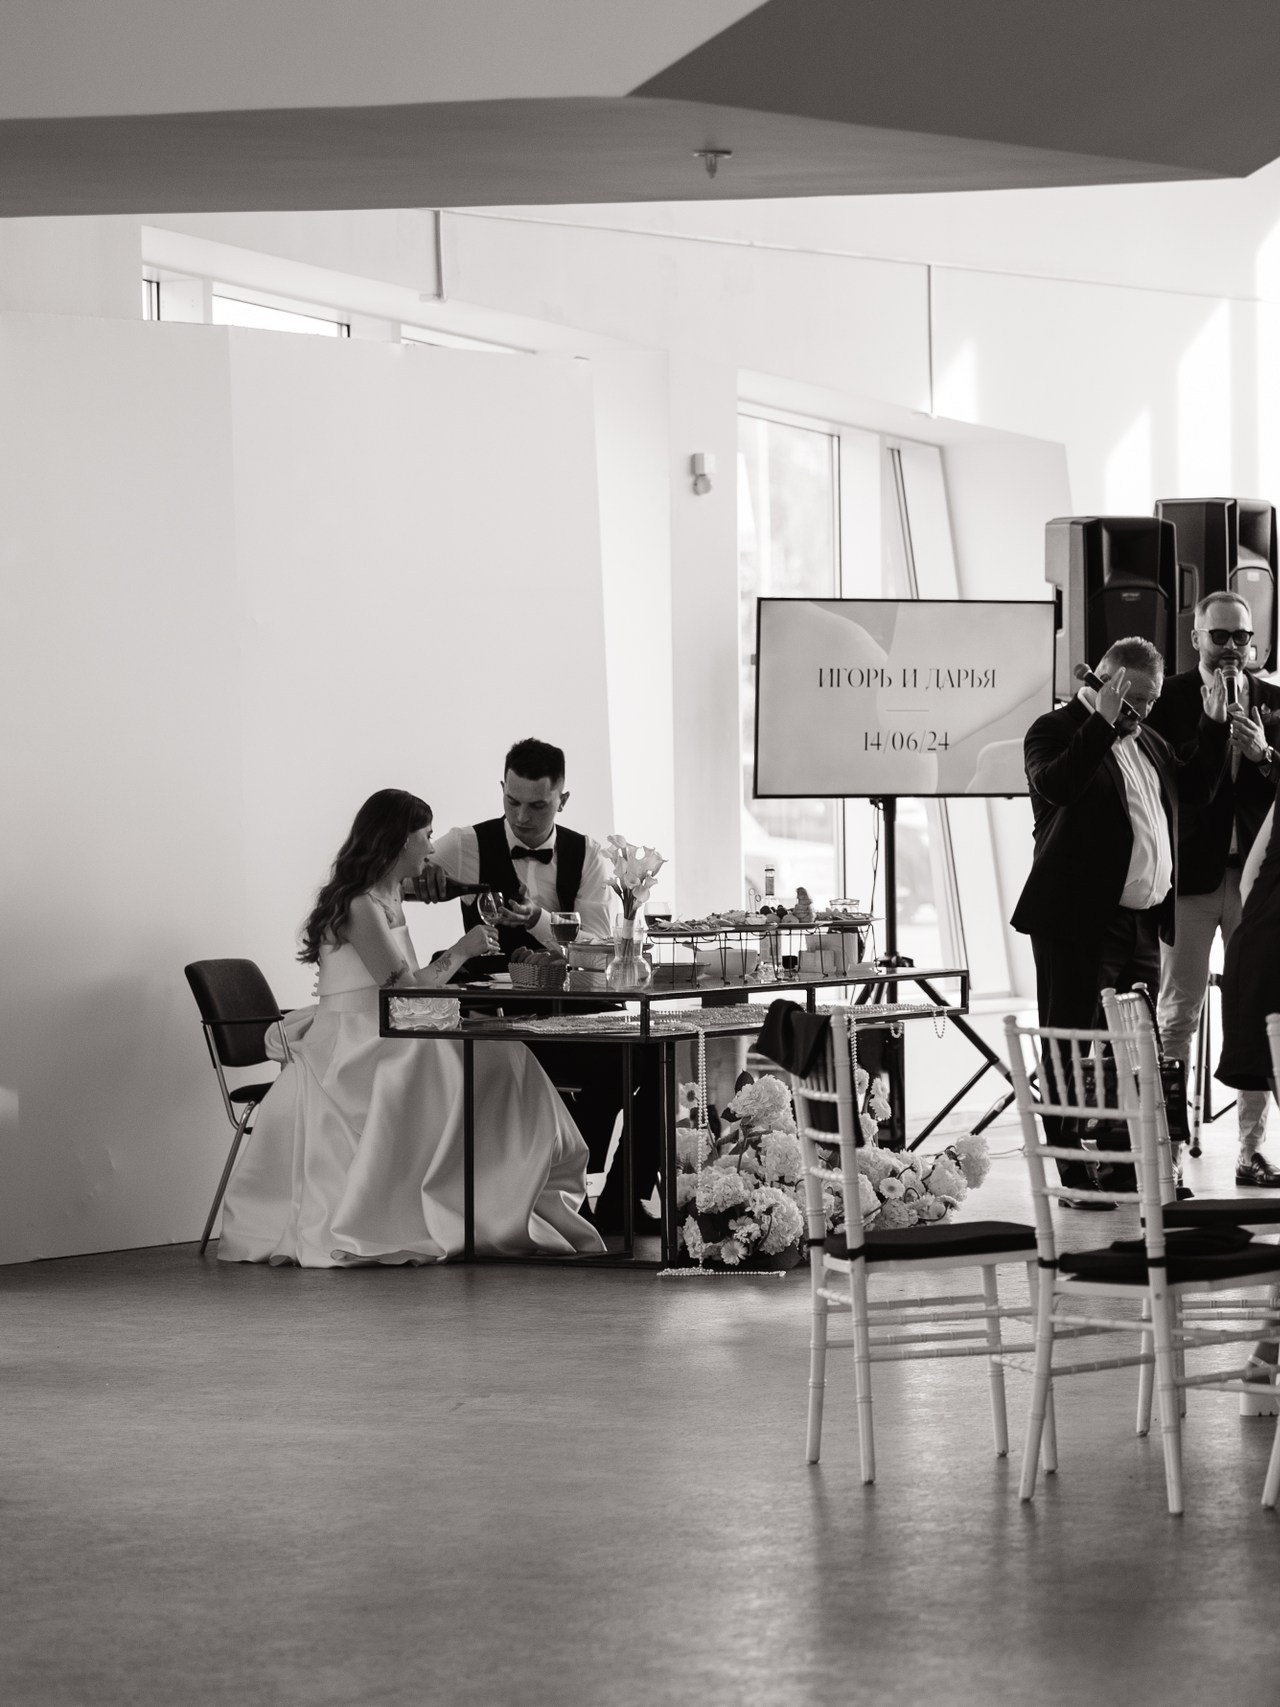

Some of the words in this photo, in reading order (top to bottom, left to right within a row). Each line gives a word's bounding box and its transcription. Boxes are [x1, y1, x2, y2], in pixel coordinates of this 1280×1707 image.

[818, 667, 892, 688] ИГОРЬ
[902, 668, 918, 688] И
[925, 668, 996, 691] ДАРЬЯ
[864, 730, 950, 754] 14/06/24
